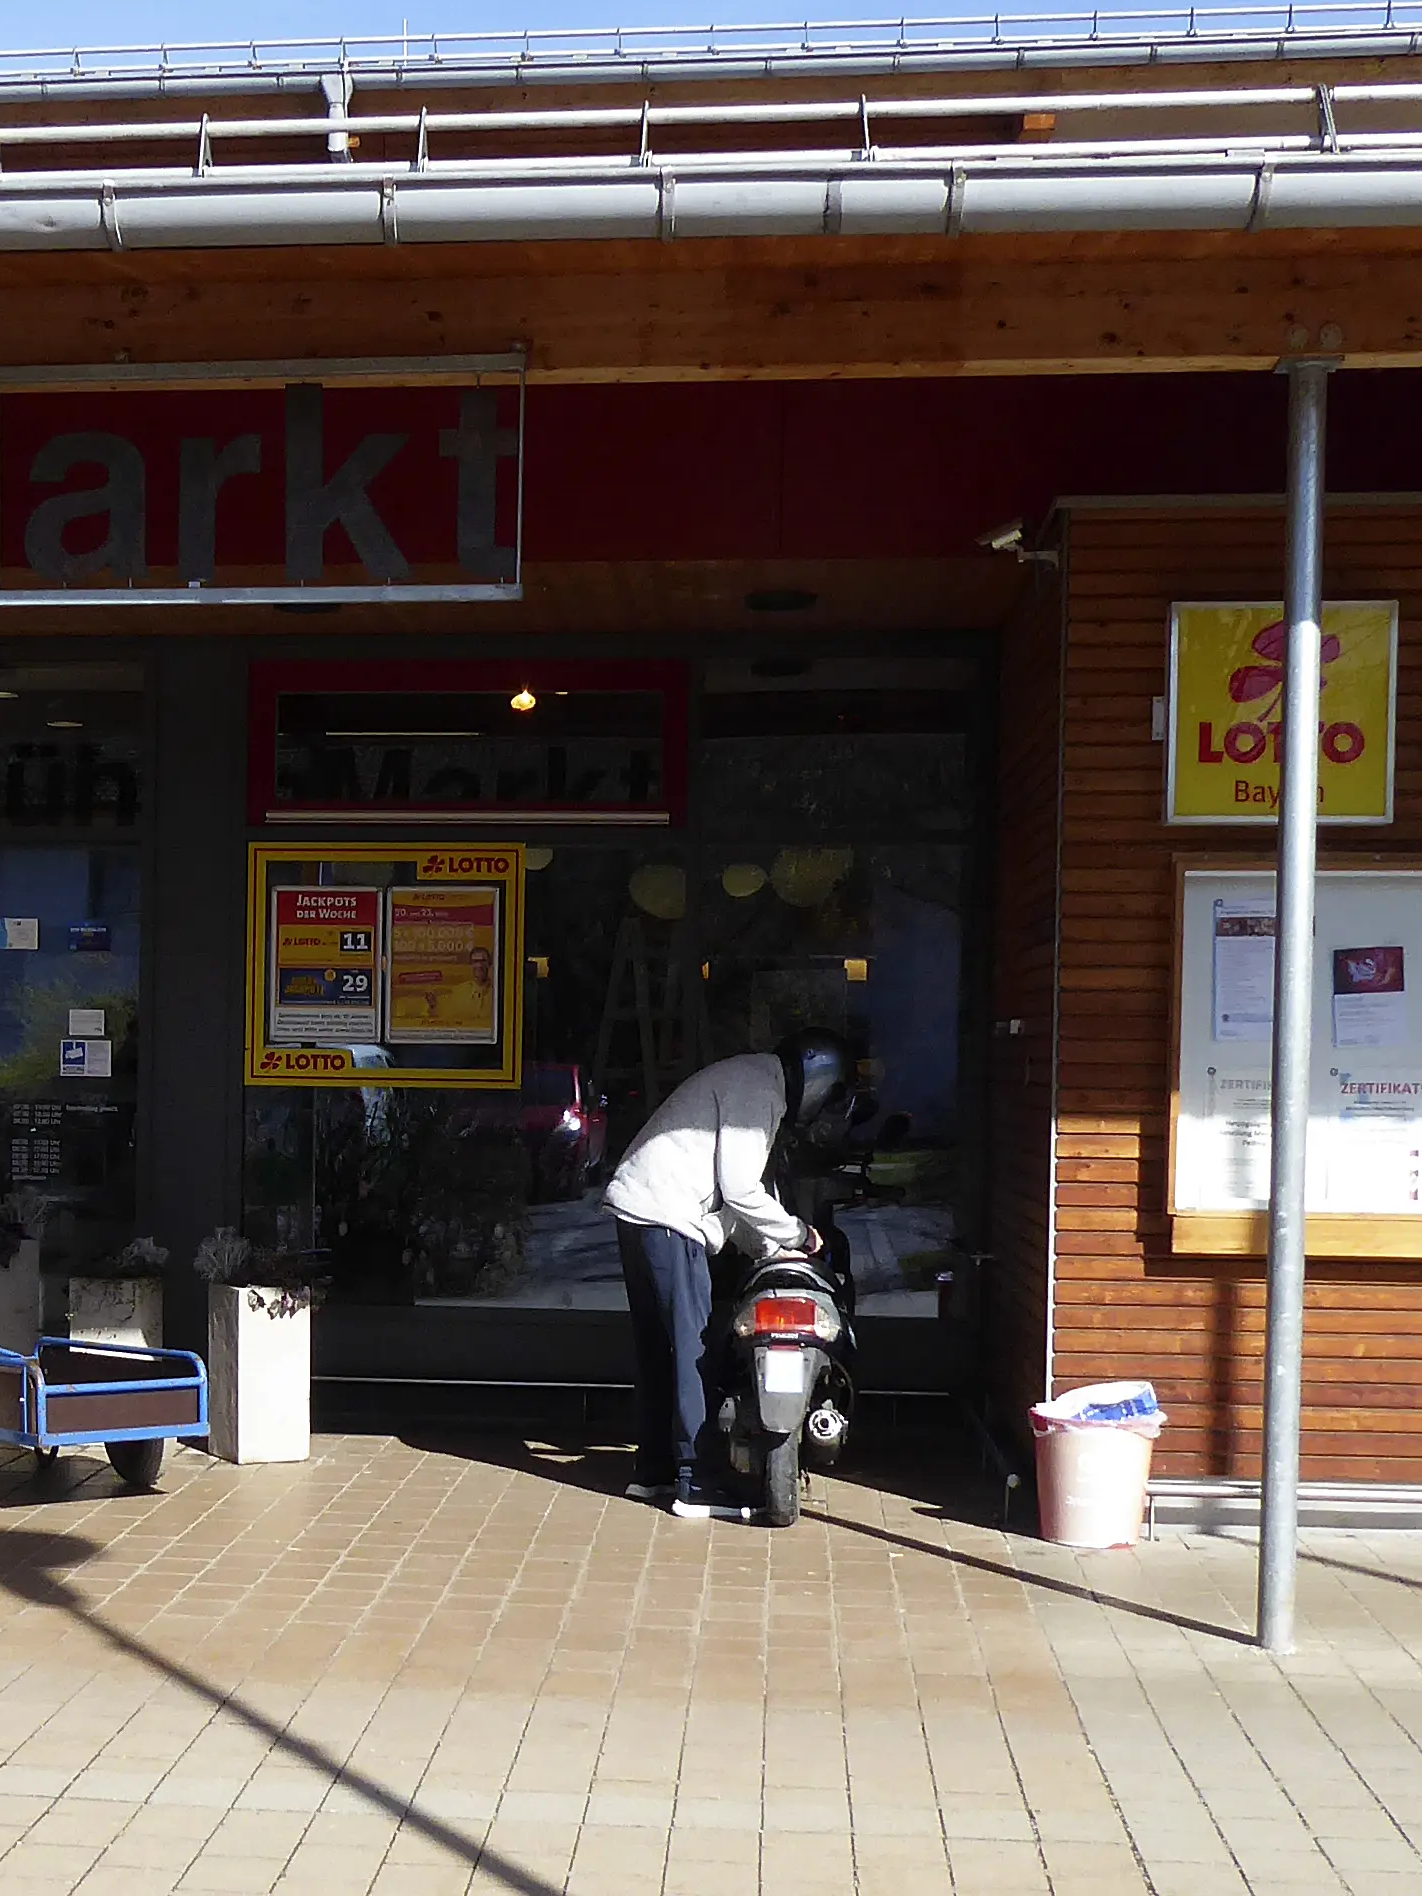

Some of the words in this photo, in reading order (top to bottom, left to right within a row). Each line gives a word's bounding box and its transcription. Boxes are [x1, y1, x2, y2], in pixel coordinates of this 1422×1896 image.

[1198, 720, 1365, 764] LOTO
[448, 856, 510, 875] LOTTO
[296, 893, 357, 907] JACKPOTS
[296, 910, 316, 919] DER
[343, 933, 369, 950] 11
[342, 974, 369, 992] 29
[285, 1053, 346, 1071] LOTTO
[1220, 1079, 1272, 1090] ZERTIFI
[1341, 1082, 1422, 1095] ZERTIFIKAT
